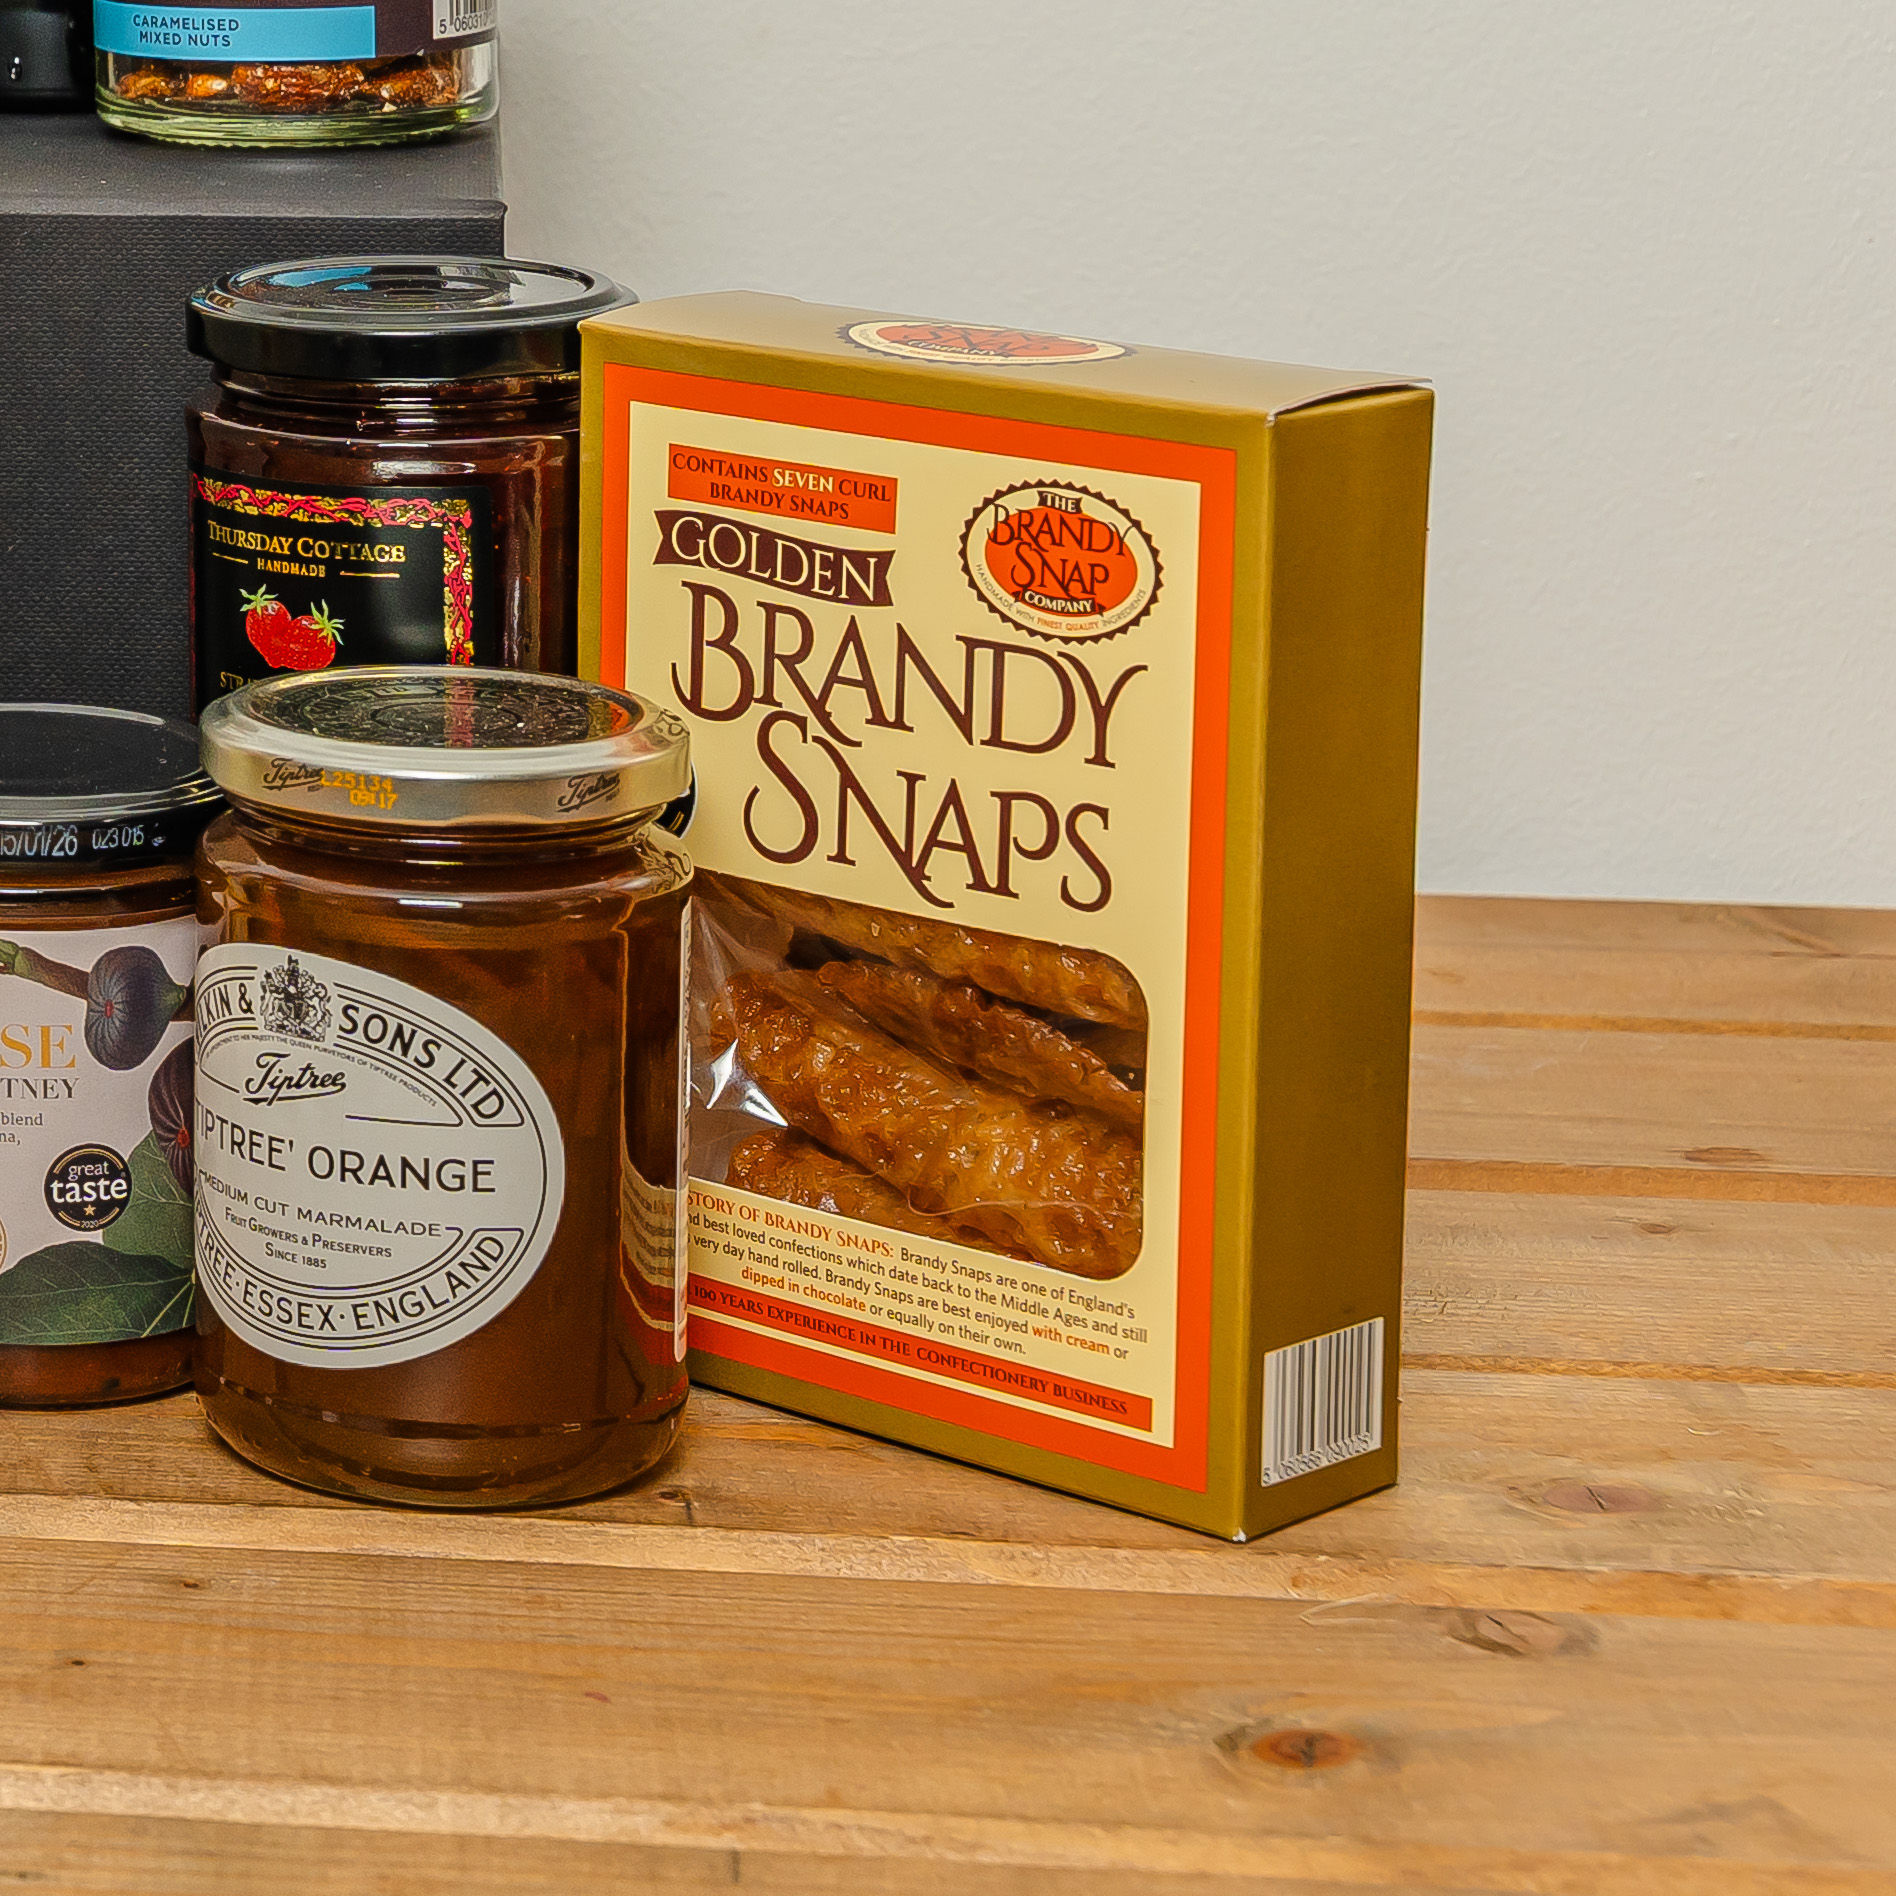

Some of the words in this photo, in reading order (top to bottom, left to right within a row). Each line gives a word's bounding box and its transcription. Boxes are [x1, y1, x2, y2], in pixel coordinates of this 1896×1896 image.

[133, 14, 239, 32] CARAMELISED
[139, 31, 183, 46] MIXED
[188, 31, 231, 47] NUTS
[673, 452, 768, 484] CONTAINS
[772, 469, 834, 493] SEVEN
[839, 478, 891, 503] CURL
[709, 482, 785, 509] BRANDY
[789, 494, 849, 519] SNAPS
[1043, 493, 1076, 512] THE
[987, 504, 1134, 557] BRANDY
[258, 558, 326, 577] HANDMADE
[671, 516, 879, 602] GOLDEN
[1011, 541, 1110, 599] SNAP
[1024, 590, 1092, 612] COMPANY
[672, 581, 1148, 769] BRANDY
[744, 710, 1110, 913] SNAPS
[244, 1052, 347, 1106] Tiptree
[338, 1003, 443, 1069] SONS
[442, 1058, 505, 1119] LTD
[1, 1110, 43, 1127] blend
[50, 1176, 128, 1203] taste
[68, 1161, 109, 1181] great
[308, 1146, 496, 1192] ORANGE
[203, 1173, 248, 1206] MEDIUM
[255, 1196, 290, 1217] CUT
[297, 1207, 441, 1237] MARMALADE
[739, 1205, 760, 1222] OF
[764, 1211, 832, 1242] BRANDY
[836, 1230, 895, 1257] SNAPS:
[901, 1247, 947, 1274] Brandy
[951, 1260, 992, 1283] Snaps
[996, 1274, 1018, 1288] are
[1022, 1281, 1047, 1296] one
[1050, 1288, 1065, 1300] of
[1069, 1289, 1135, 1320] England's
